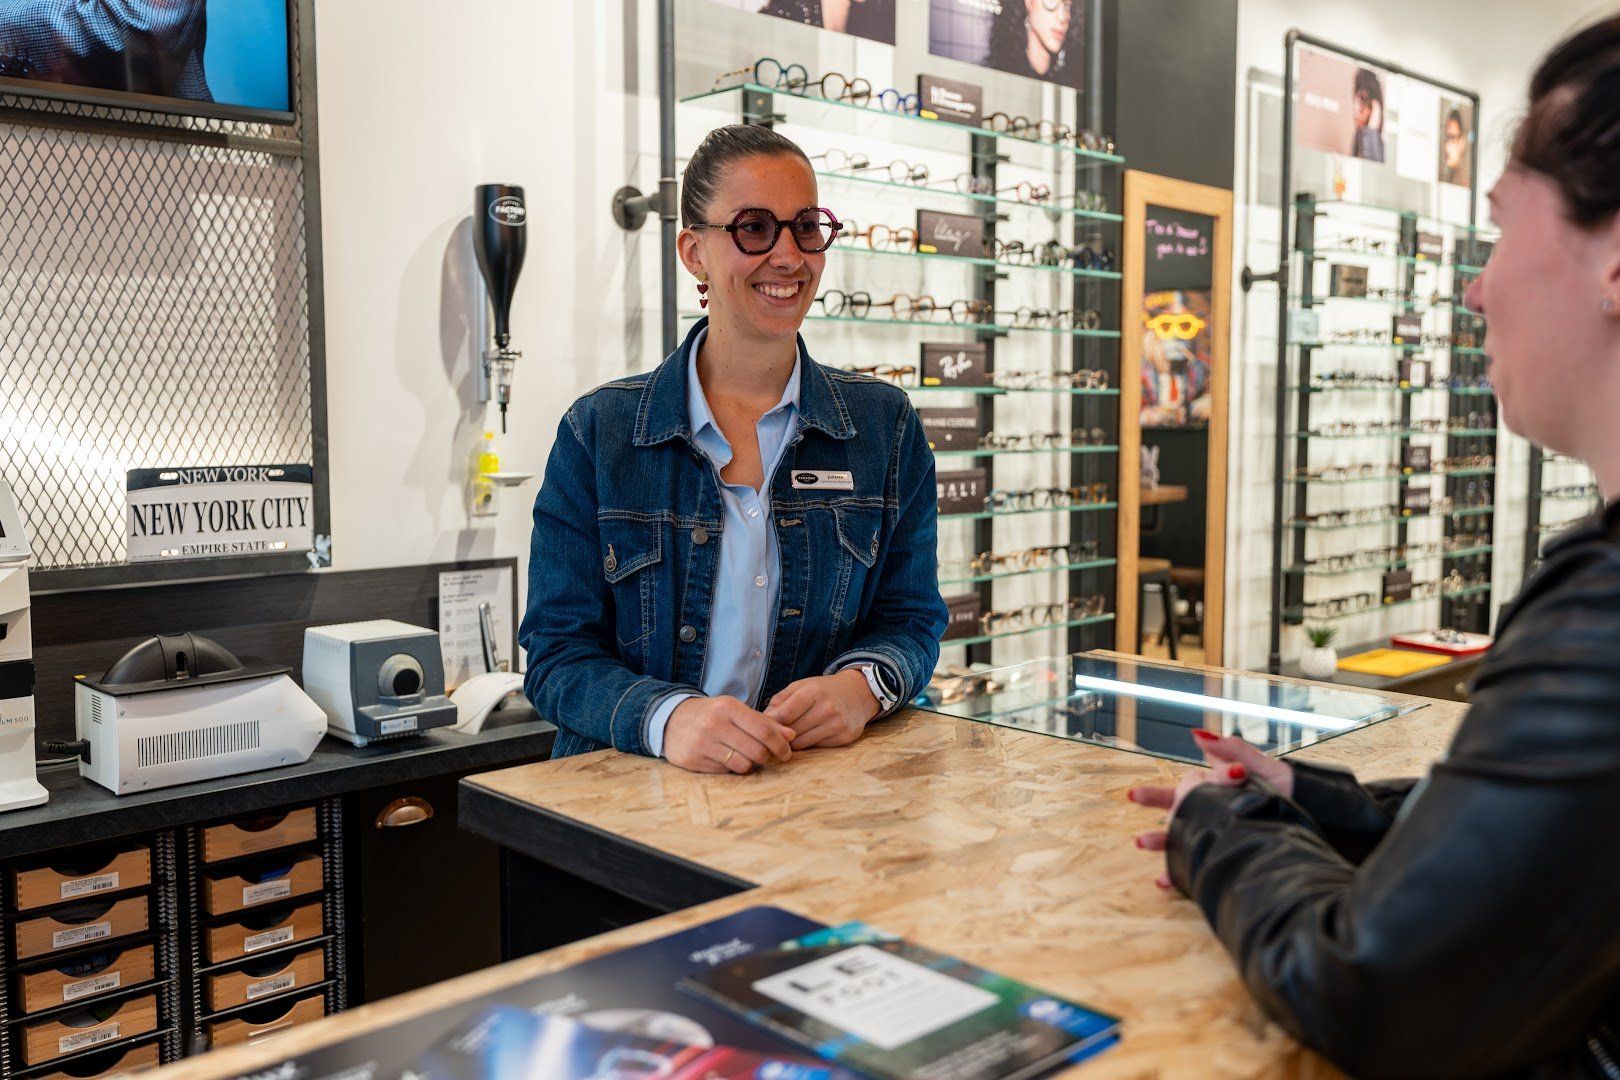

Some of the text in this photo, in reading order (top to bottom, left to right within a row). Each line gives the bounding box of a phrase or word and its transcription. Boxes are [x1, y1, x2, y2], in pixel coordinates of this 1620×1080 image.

[177, 466, 270, 485] NEW YORK
[131, 497, 309, 537] NEW YORK CITY
[182, 540, 268, 556] EMPIRE STATE
